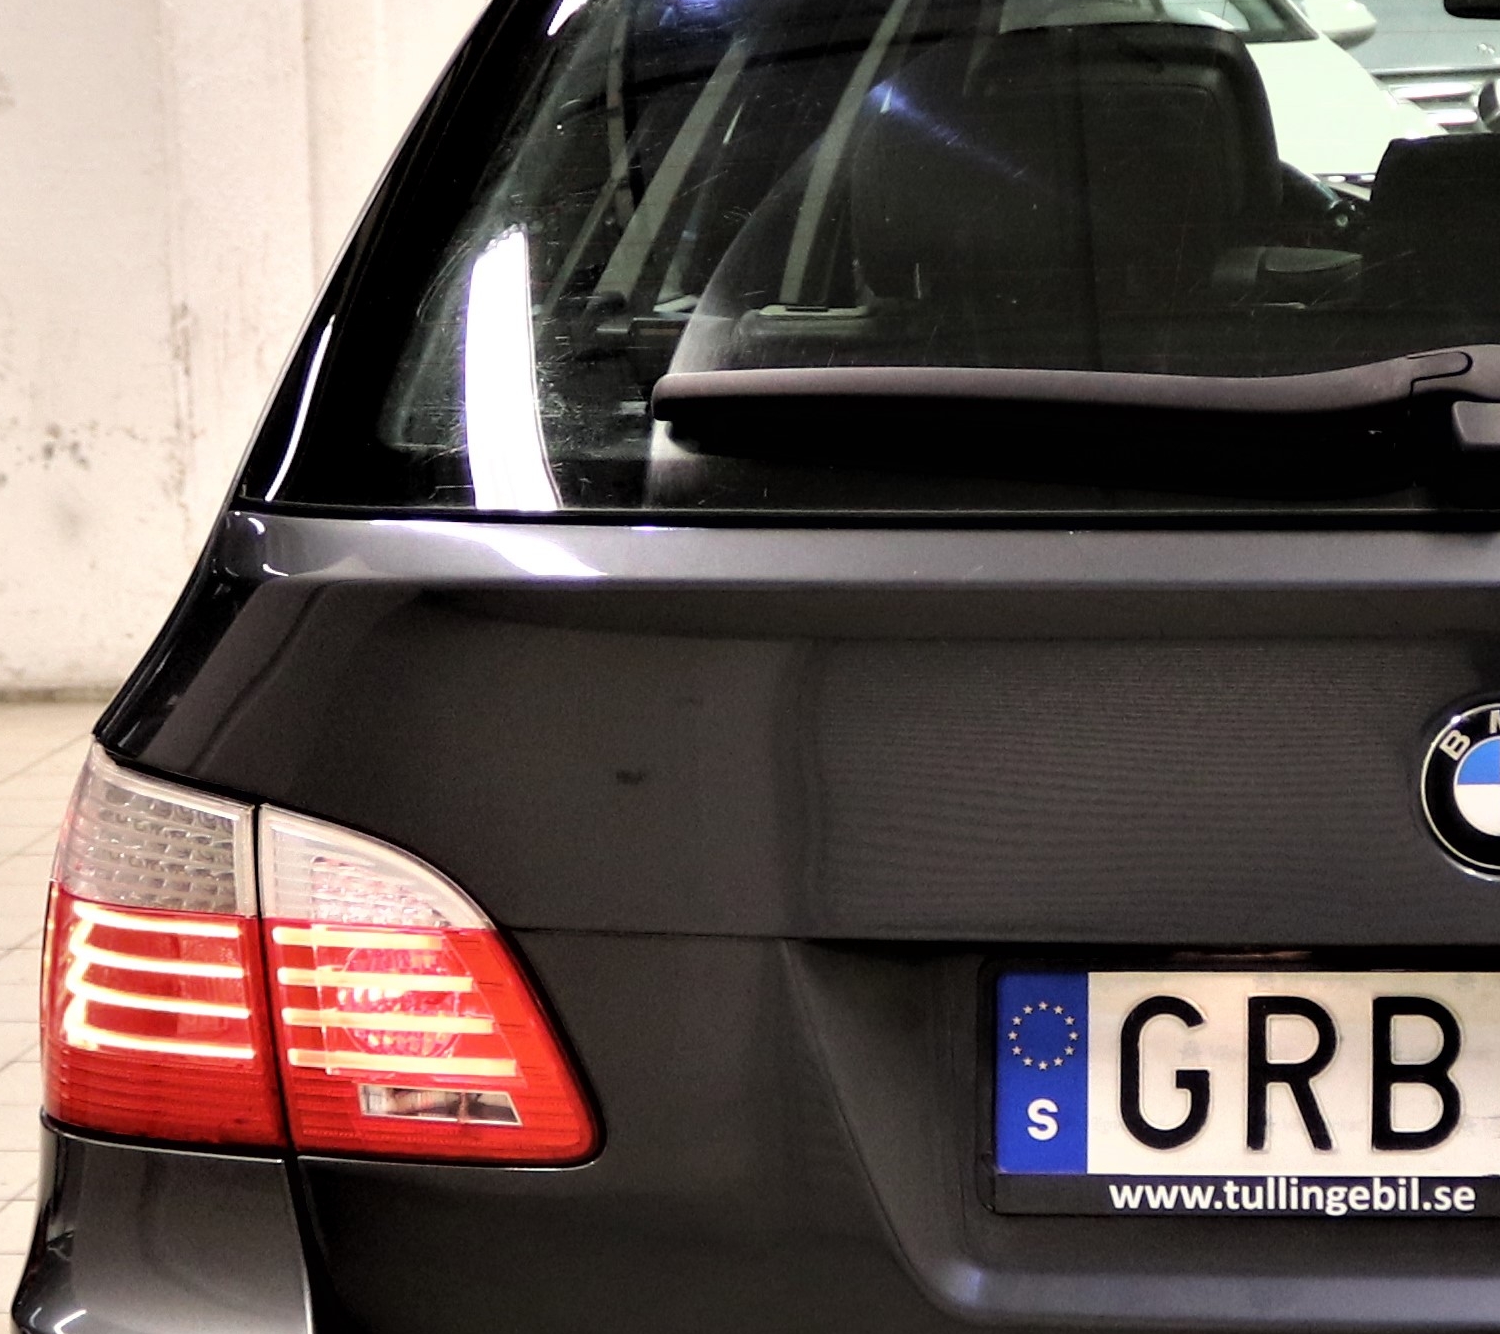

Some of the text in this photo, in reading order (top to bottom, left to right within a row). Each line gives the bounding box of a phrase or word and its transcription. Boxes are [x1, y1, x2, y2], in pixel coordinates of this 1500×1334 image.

[1119, 994, 1463, 1152] GRB
[1026, 1097, 1059, 1142] S
[1107, 1176, 1477, 1217] www.tullingebil.se
